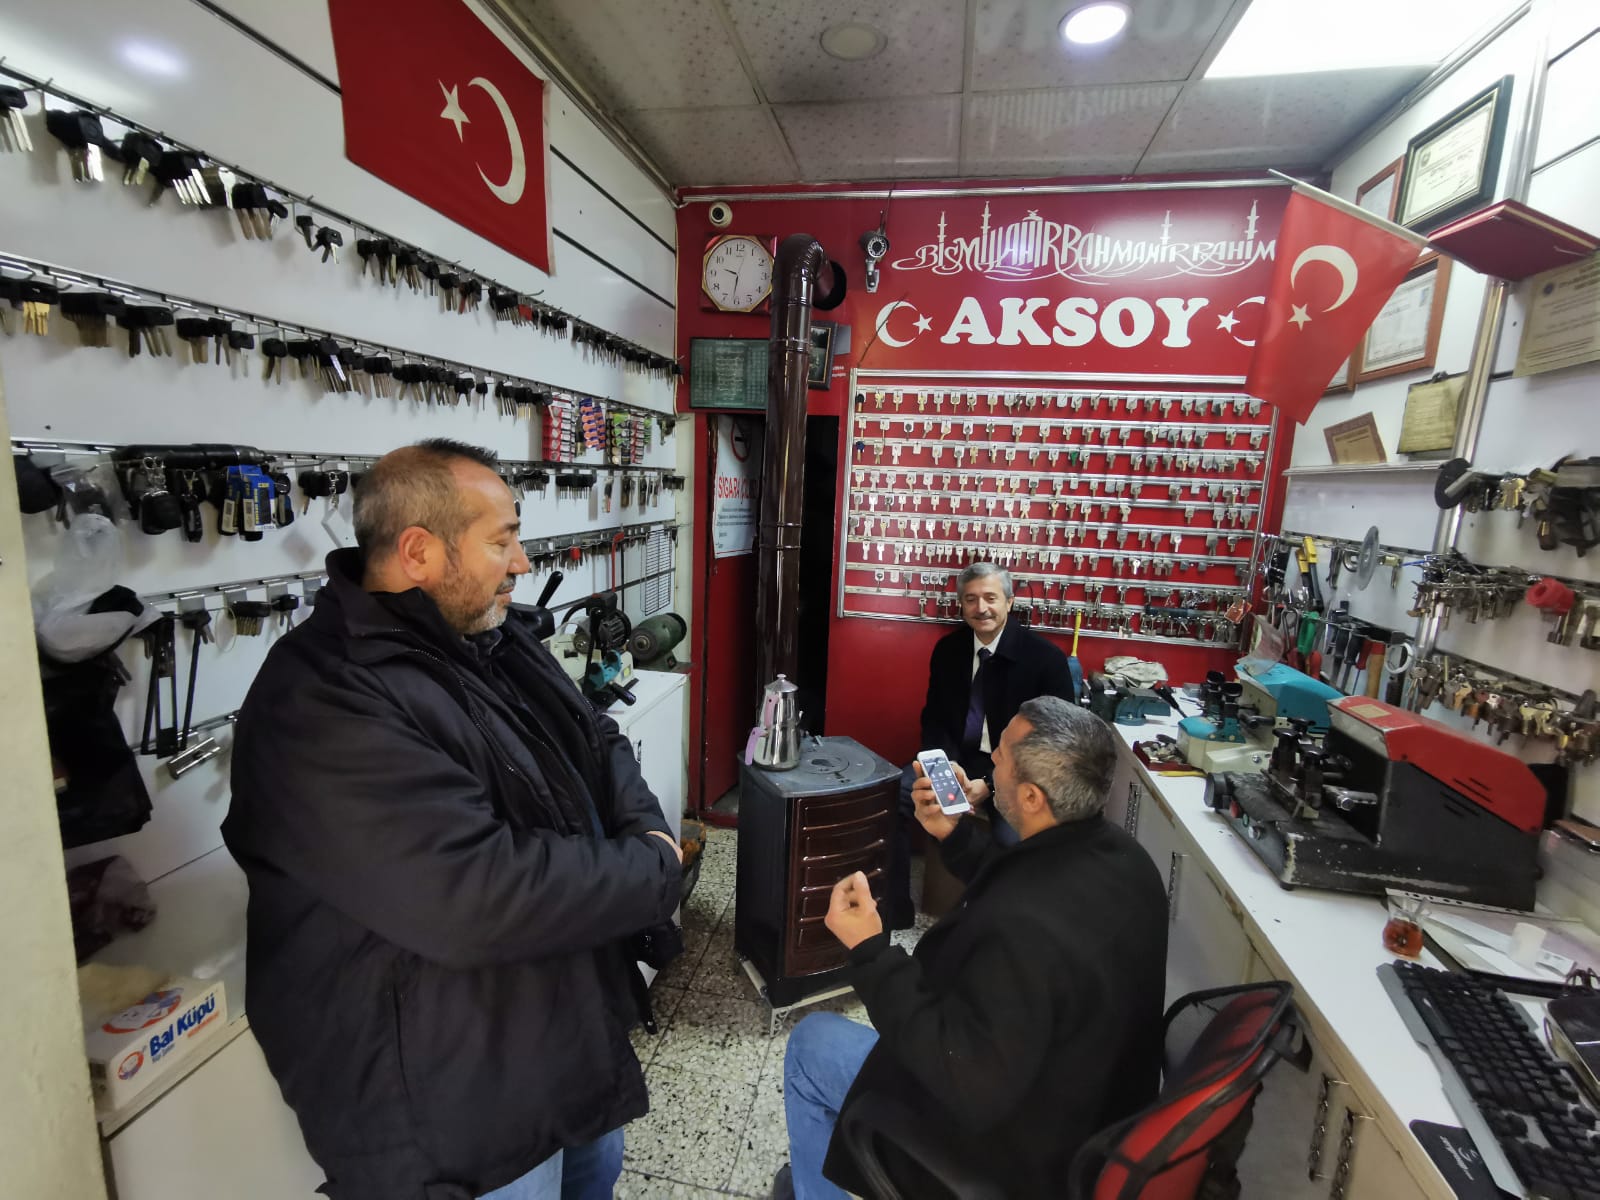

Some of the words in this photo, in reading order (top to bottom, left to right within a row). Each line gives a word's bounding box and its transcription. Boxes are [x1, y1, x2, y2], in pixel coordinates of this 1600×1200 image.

[735, 242, 746, 252] 12
[940, 296, 1209, 348] AKSOY
[149, 1023, 174, 1057] Bal
[177, 992, 215, 1036] Küpü
